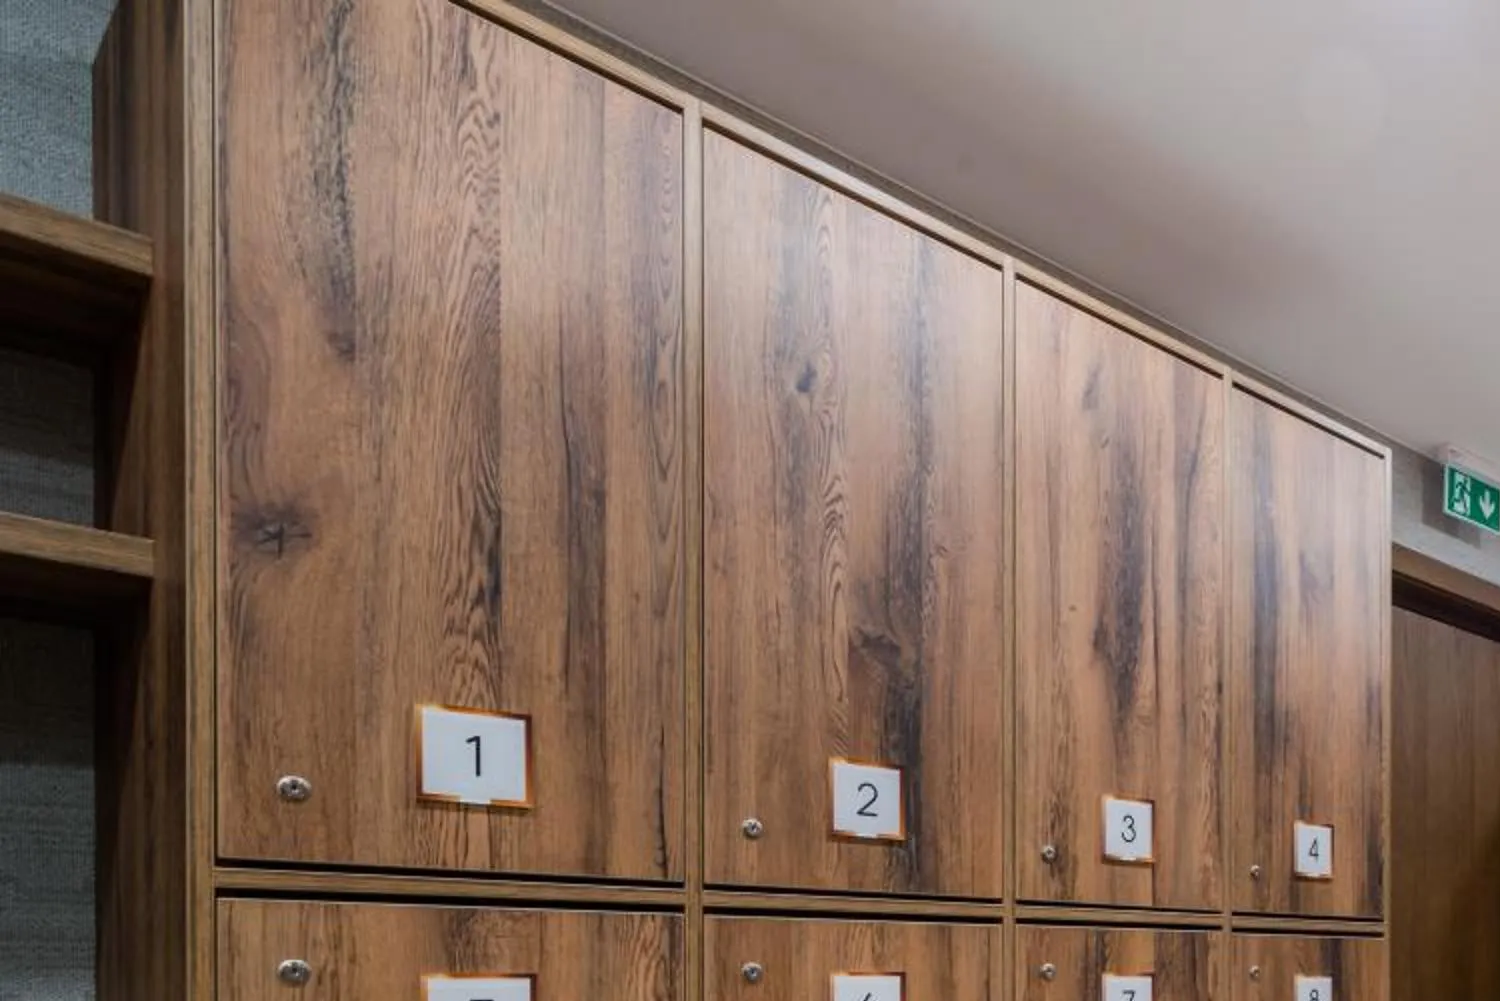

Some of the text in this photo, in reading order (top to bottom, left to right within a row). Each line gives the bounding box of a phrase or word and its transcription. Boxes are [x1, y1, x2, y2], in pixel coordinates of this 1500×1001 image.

[466, 736, 481, 777] 1
[857, 782, 879, 817] 2
[1121, 815, 1137, 843] 3
[1308, 838, 1320, 859] 4
